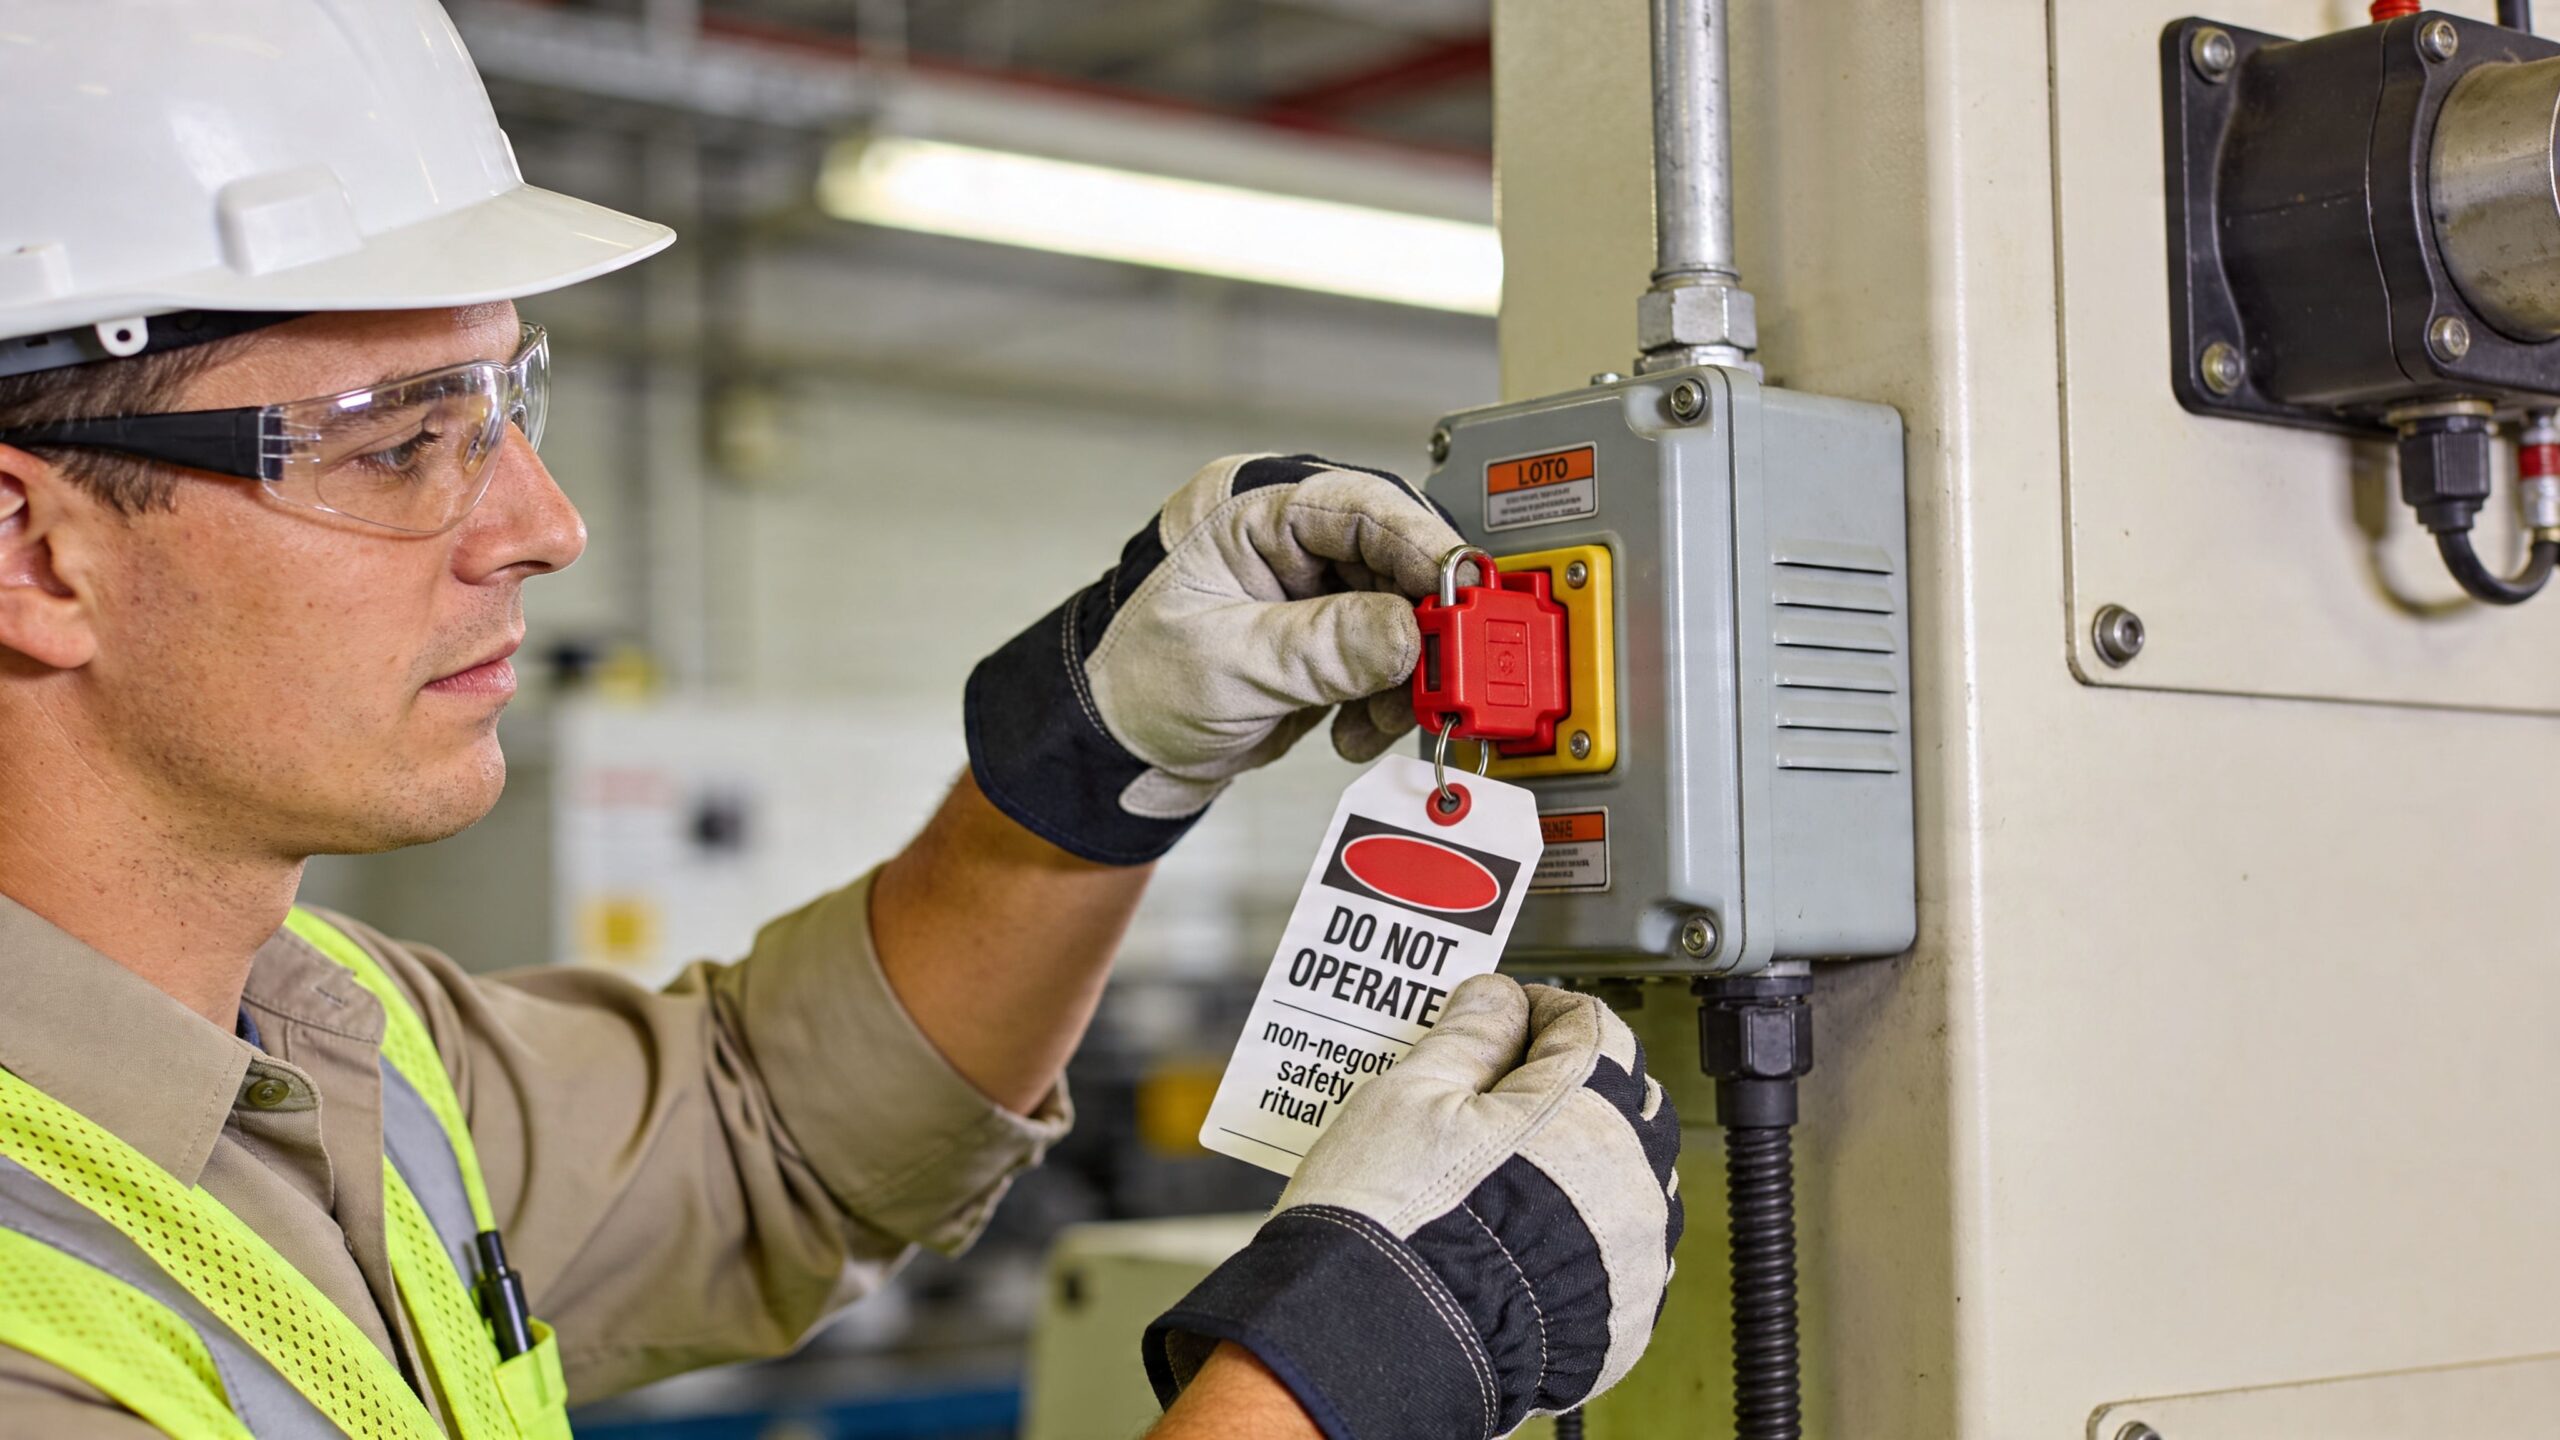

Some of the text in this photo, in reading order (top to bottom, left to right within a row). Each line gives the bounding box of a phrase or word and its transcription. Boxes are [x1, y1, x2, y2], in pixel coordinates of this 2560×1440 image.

[1518, 457, 1568, 485] LOTO
[1323, 905, 1459, 977] DO NOT
[1288, 947, 1447, 1030] OPERATE
[1262, 1021, 1400, 1076] non-negoti
[1259, 1087, 1328, 1128] ritual
[1277, 1060, 1355, 1105] safety
